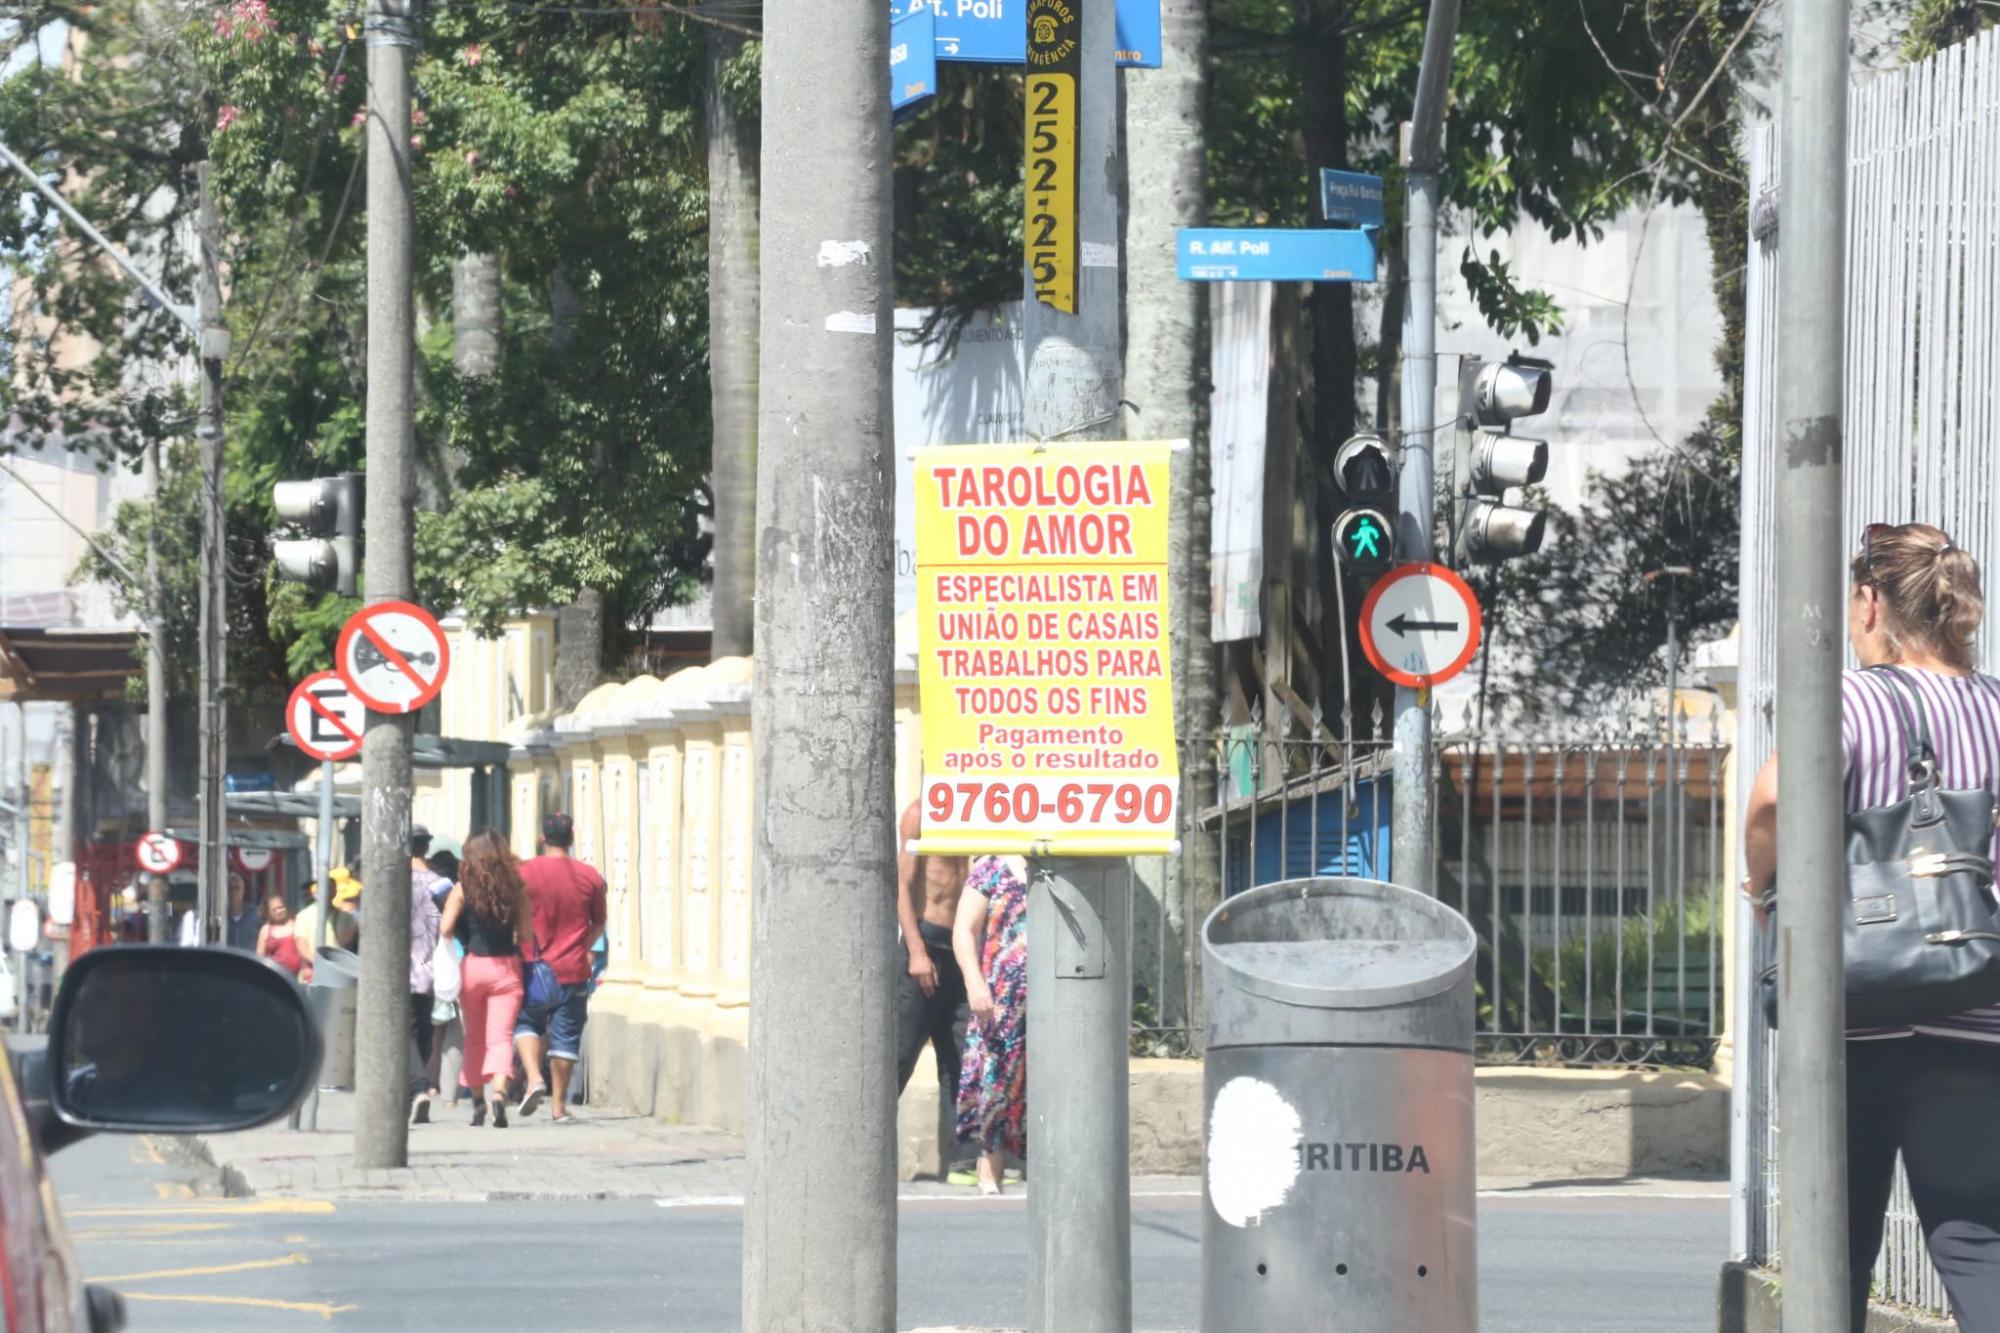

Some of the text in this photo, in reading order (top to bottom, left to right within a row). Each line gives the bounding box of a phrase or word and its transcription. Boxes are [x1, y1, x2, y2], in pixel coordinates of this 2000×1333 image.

[957, 0, 1002, 19] Poli
[1189, 240, 1207, 255] R.
[1240, 240, 1269, 256] Poli
[933, 464, 1151, 508] TAROLOGIA
[958, 513, 1133, 556] DO AMOR
[937, 574, 1113, 603] ESPECIALISTA
[1122, 574, 1158, 602] EM
[938, 607, 1160, 641] UNIÃO DE CASAIS
[936, 648, 1161, 677] TRABALHOS PARA
[955, 687, 1147, 715] TODOS OS FINS
[979, 723, 1124, 750] Pagamento
[1011, 752, 1026, 768] o
[1035, 748, 1159, 769] resultado
[928, 782, 1173, 824] 9760-6790
[1296, 1142, 1430, 1174] RITIBA
